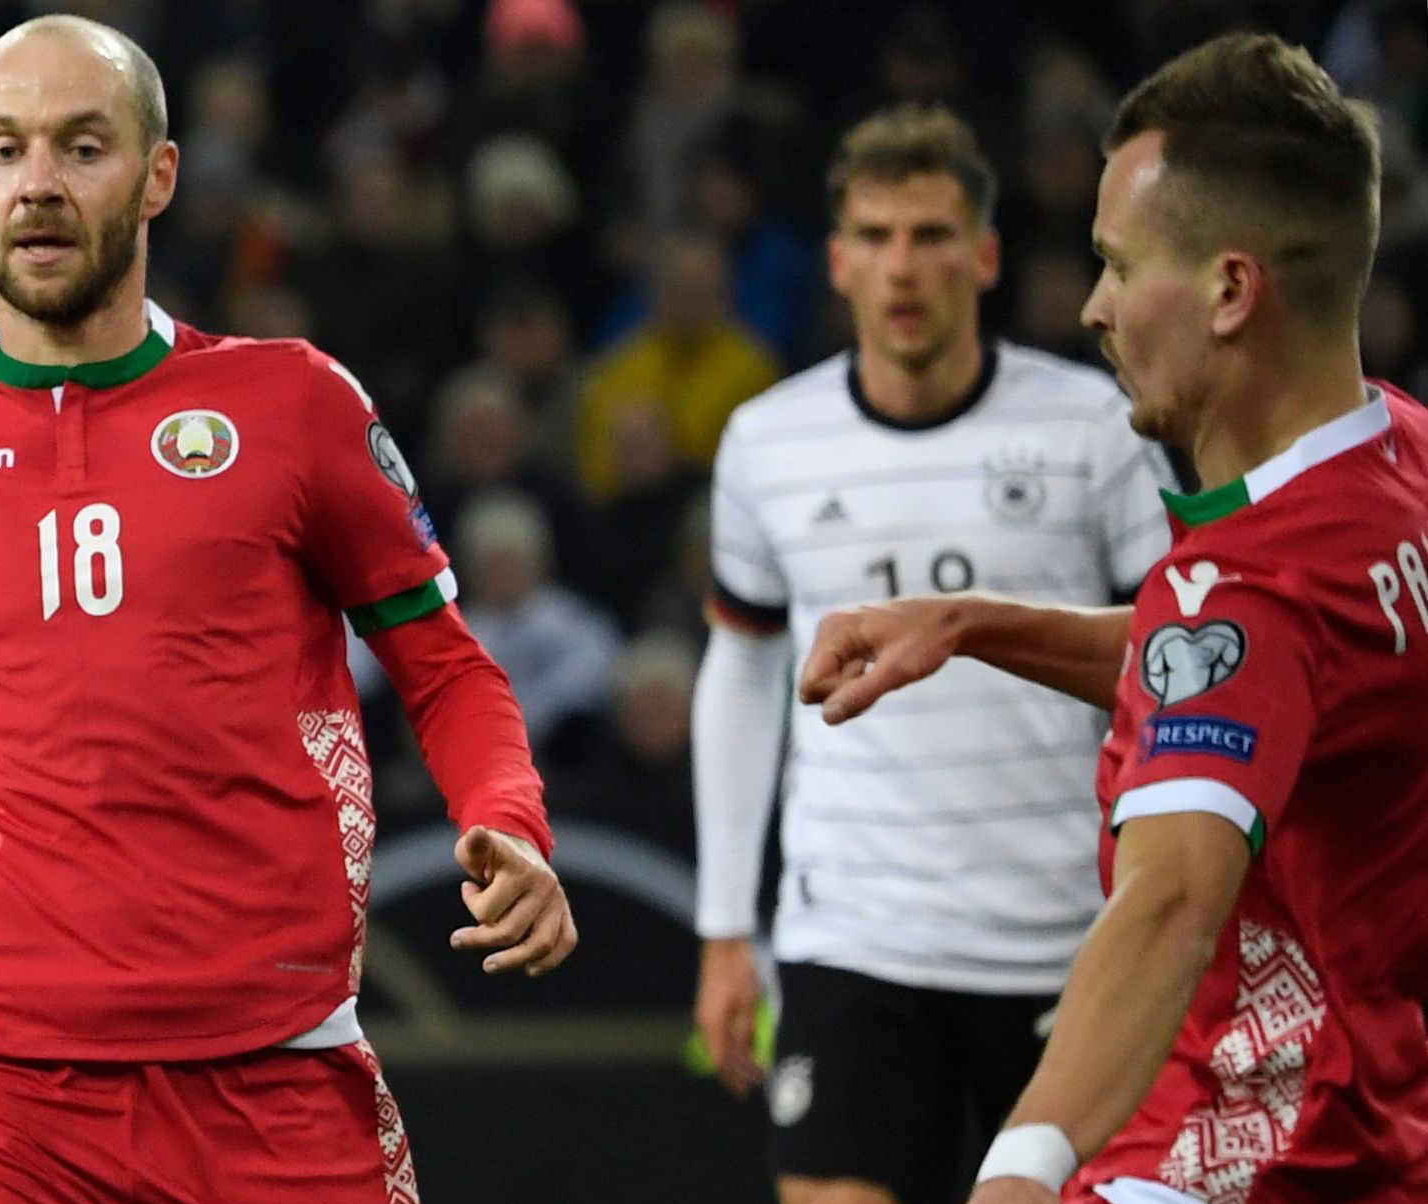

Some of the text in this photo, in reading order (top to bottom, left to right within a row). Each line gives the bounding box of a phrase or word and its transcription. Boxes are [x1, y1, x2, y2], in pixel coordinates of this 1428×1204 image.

[37, 502, 124, 622] 18
[1368, 532, 1428, 655] PA
[1156, 722, 1253, 753] RESPECT
